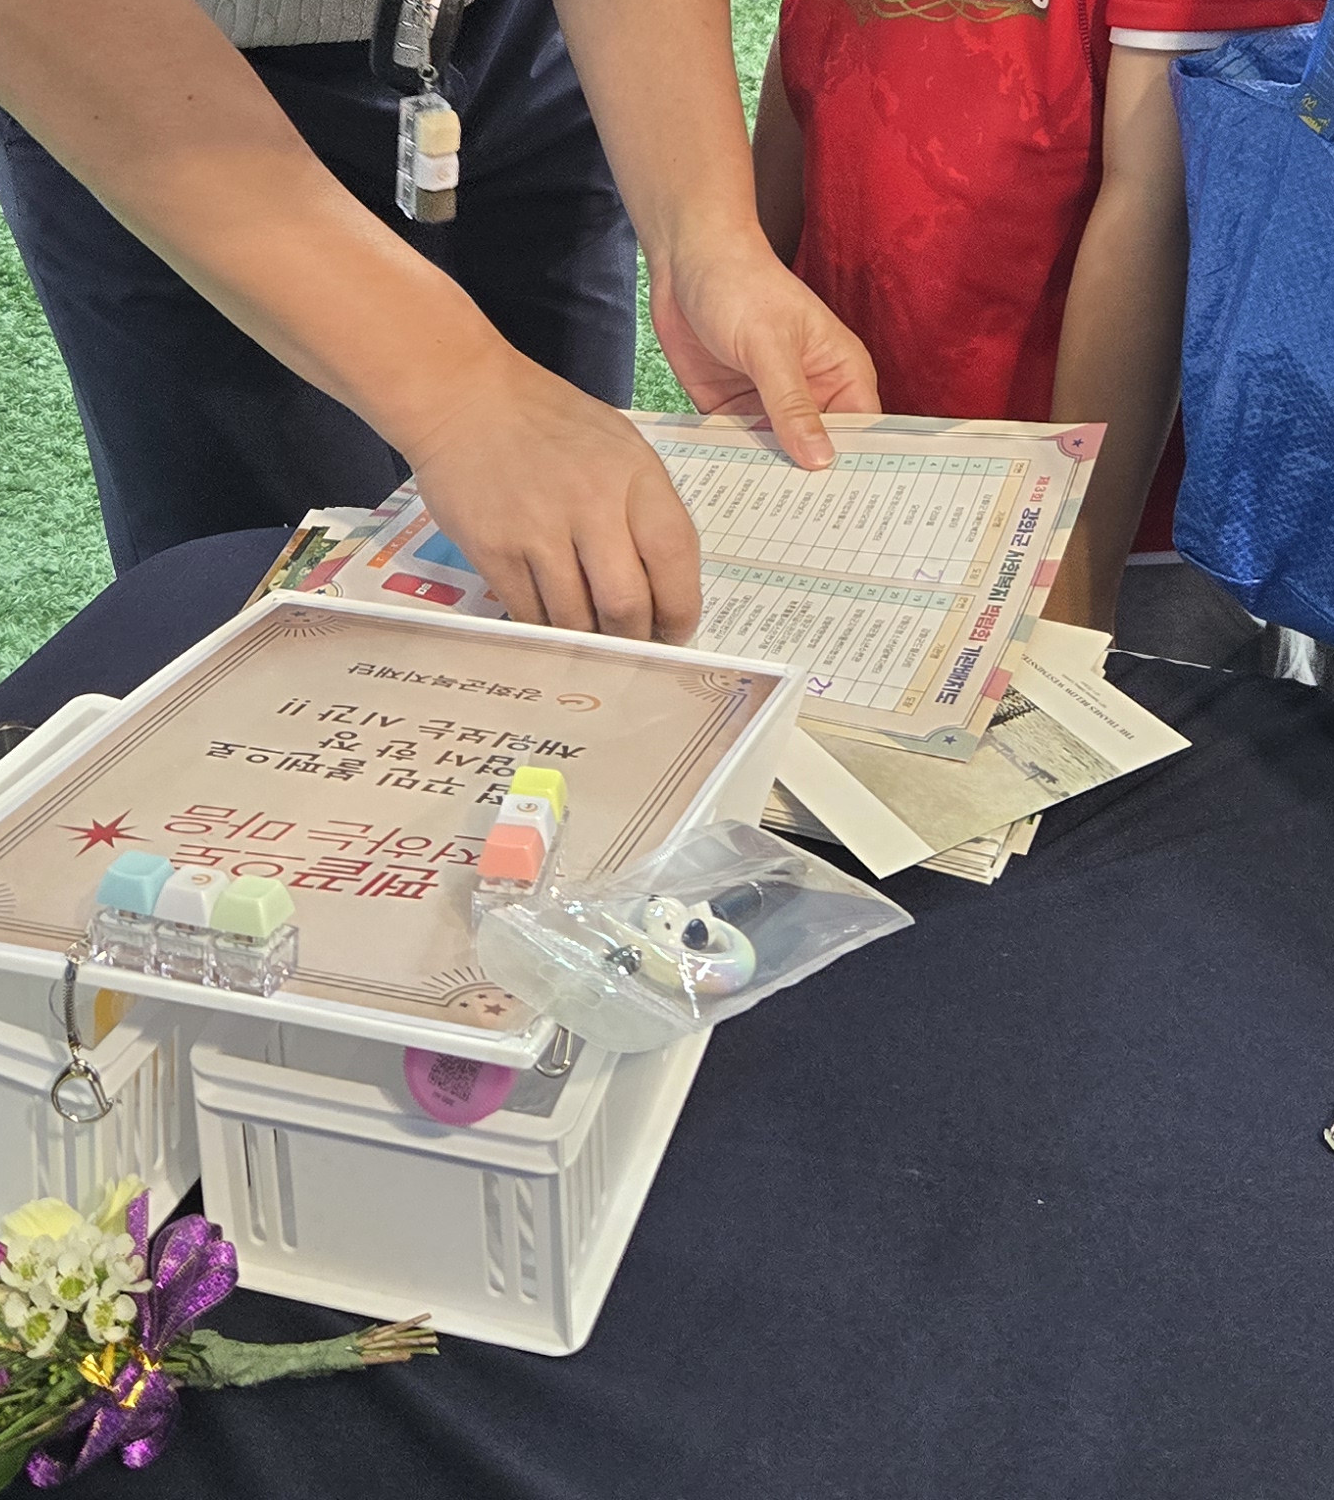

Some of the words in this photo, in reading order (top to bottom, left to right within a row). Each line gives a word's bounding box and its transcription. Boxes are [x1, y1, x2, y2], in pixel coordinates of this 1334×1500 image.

[1030, 476, 1051, 503] 제3회
[1011, 508, 1042, 547] 강화군
[988, 550, 1025, 602] 사회복지
[969, 605, 1002, 642] 박람회
[349, 663, 541, 702] 강화군복지재단
[936, 646, 983, 705] 기관배치도
[318, 705, 405, 728] 시간
[319, 731, 362, 752] 장
[377, 740, 418, 761] 한
[420, 720, 585, 759] 채워보는
[207, 741, 366, 781] 볼펜으로
[435, 751, 516, 777] 엽서
[377, 768, 465, 796] 꾸민
[165, 805, 296, 841] 마음
[309, 821, 490, 866] 전하는
[172, 830, 437, 899] 펜끝으로
